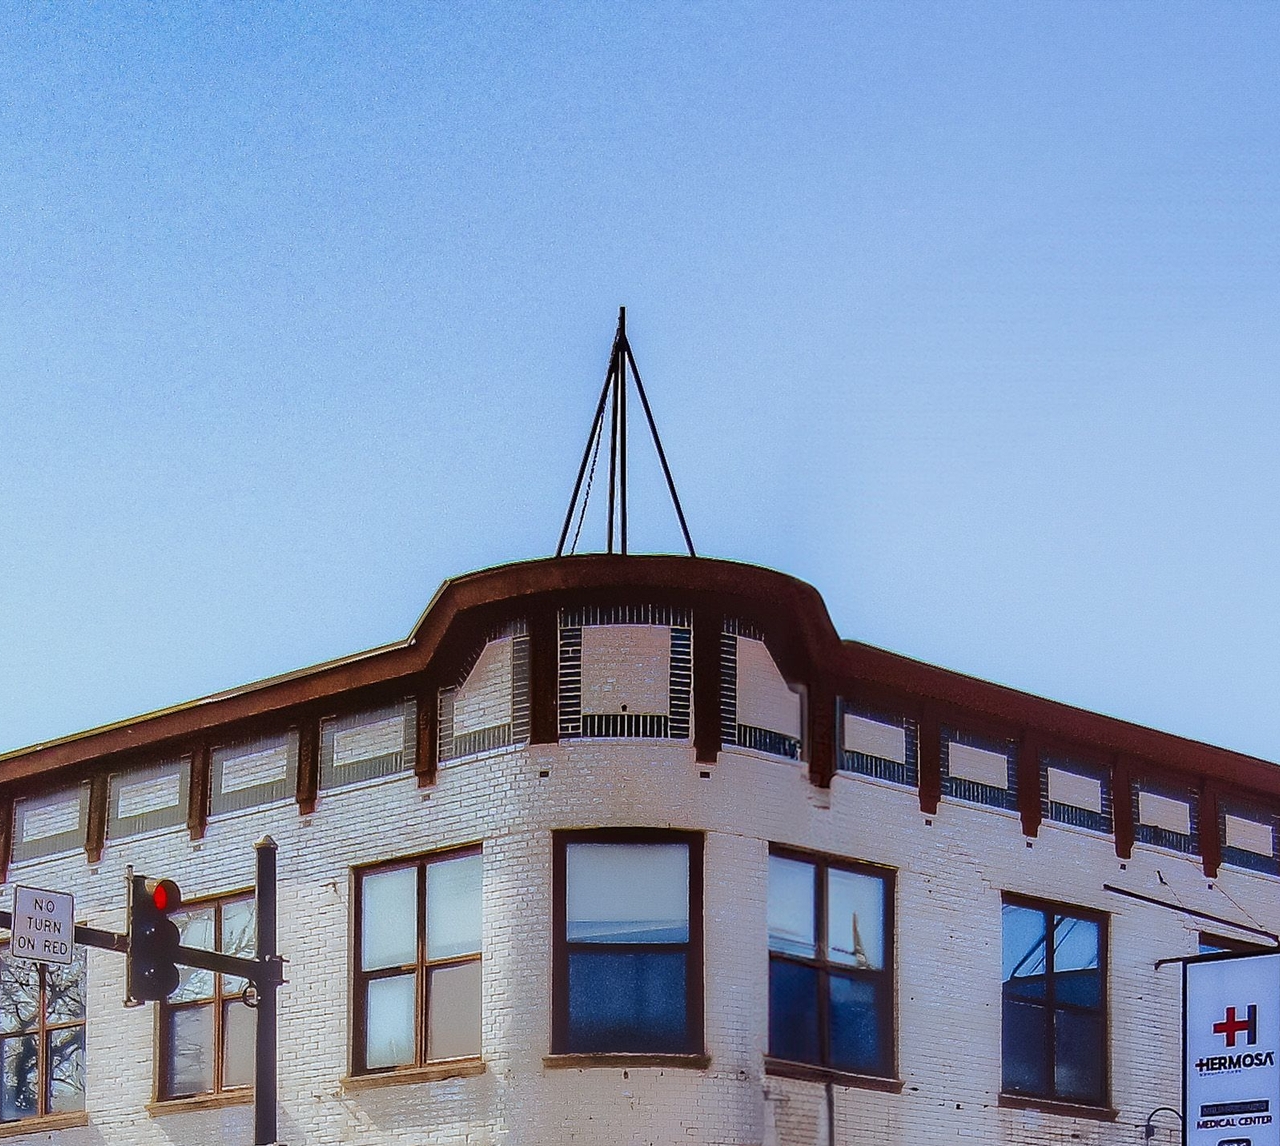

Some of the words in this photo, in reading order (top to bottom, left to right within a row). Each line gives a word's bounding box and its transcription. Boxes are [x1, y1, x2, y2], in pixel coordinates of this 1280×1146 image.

[34, 898, 56, 913] NO
[27, 917, 63, 934] TURN
[18, 935, 36, 950] ON
[43, 940, 69, 956] RED
[1195, 1051, 1274, 1072] HERMOSA
[1197, 1118, 1236, 1129] MEDICAL
[1238, 1115, 1272, 1126] CENTER
